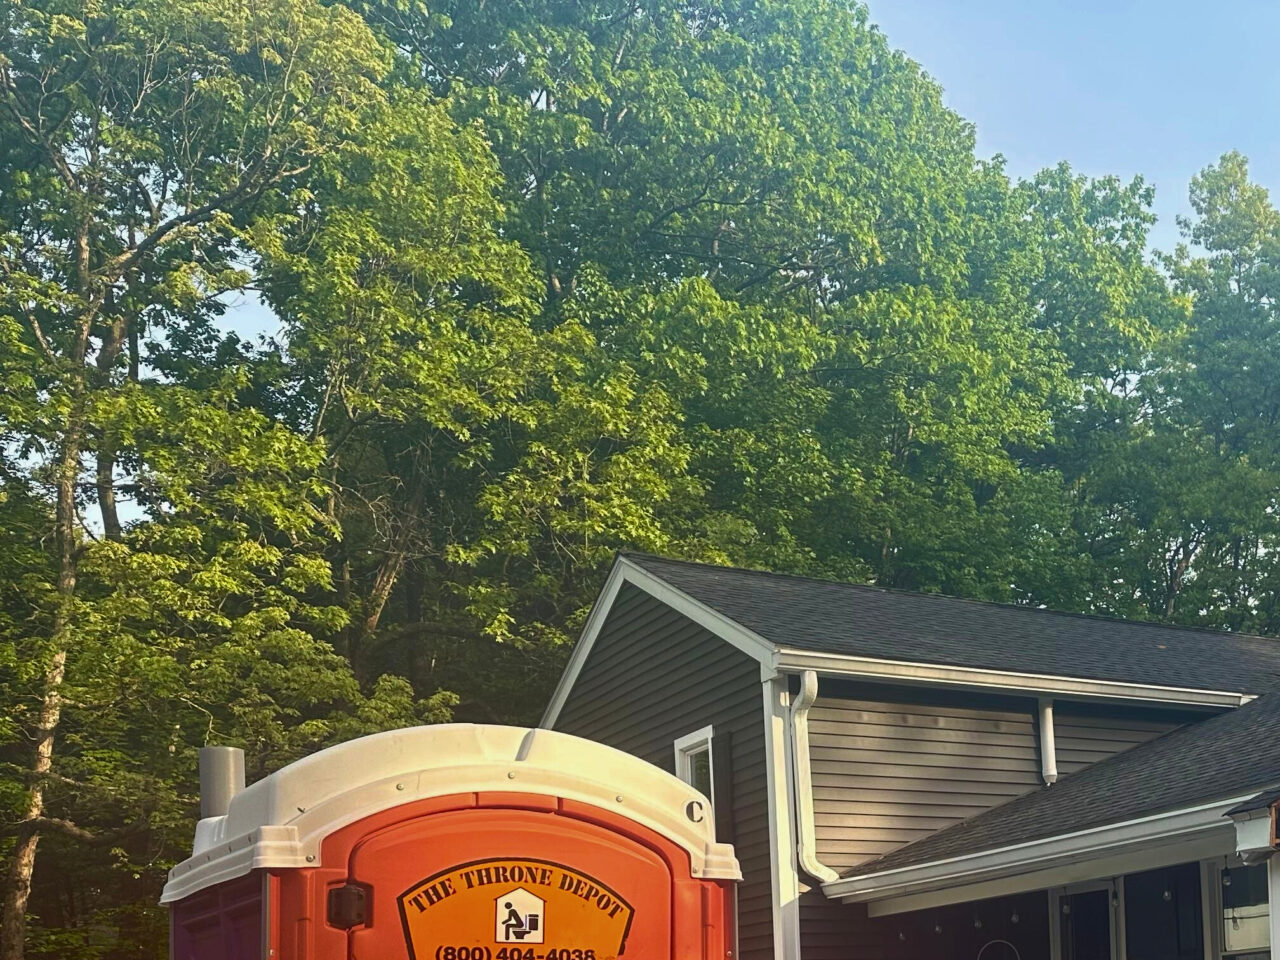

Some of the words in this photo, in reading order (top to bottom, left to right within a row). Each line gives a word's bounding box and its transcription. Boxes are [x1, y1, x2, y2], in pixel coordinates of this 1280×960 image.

[685, 801, 703, 823] C
[408, 878, 457, 914] THE
[460, 865, 553, 889] THRONE
[558, 873, 624, 919] DEPOT
